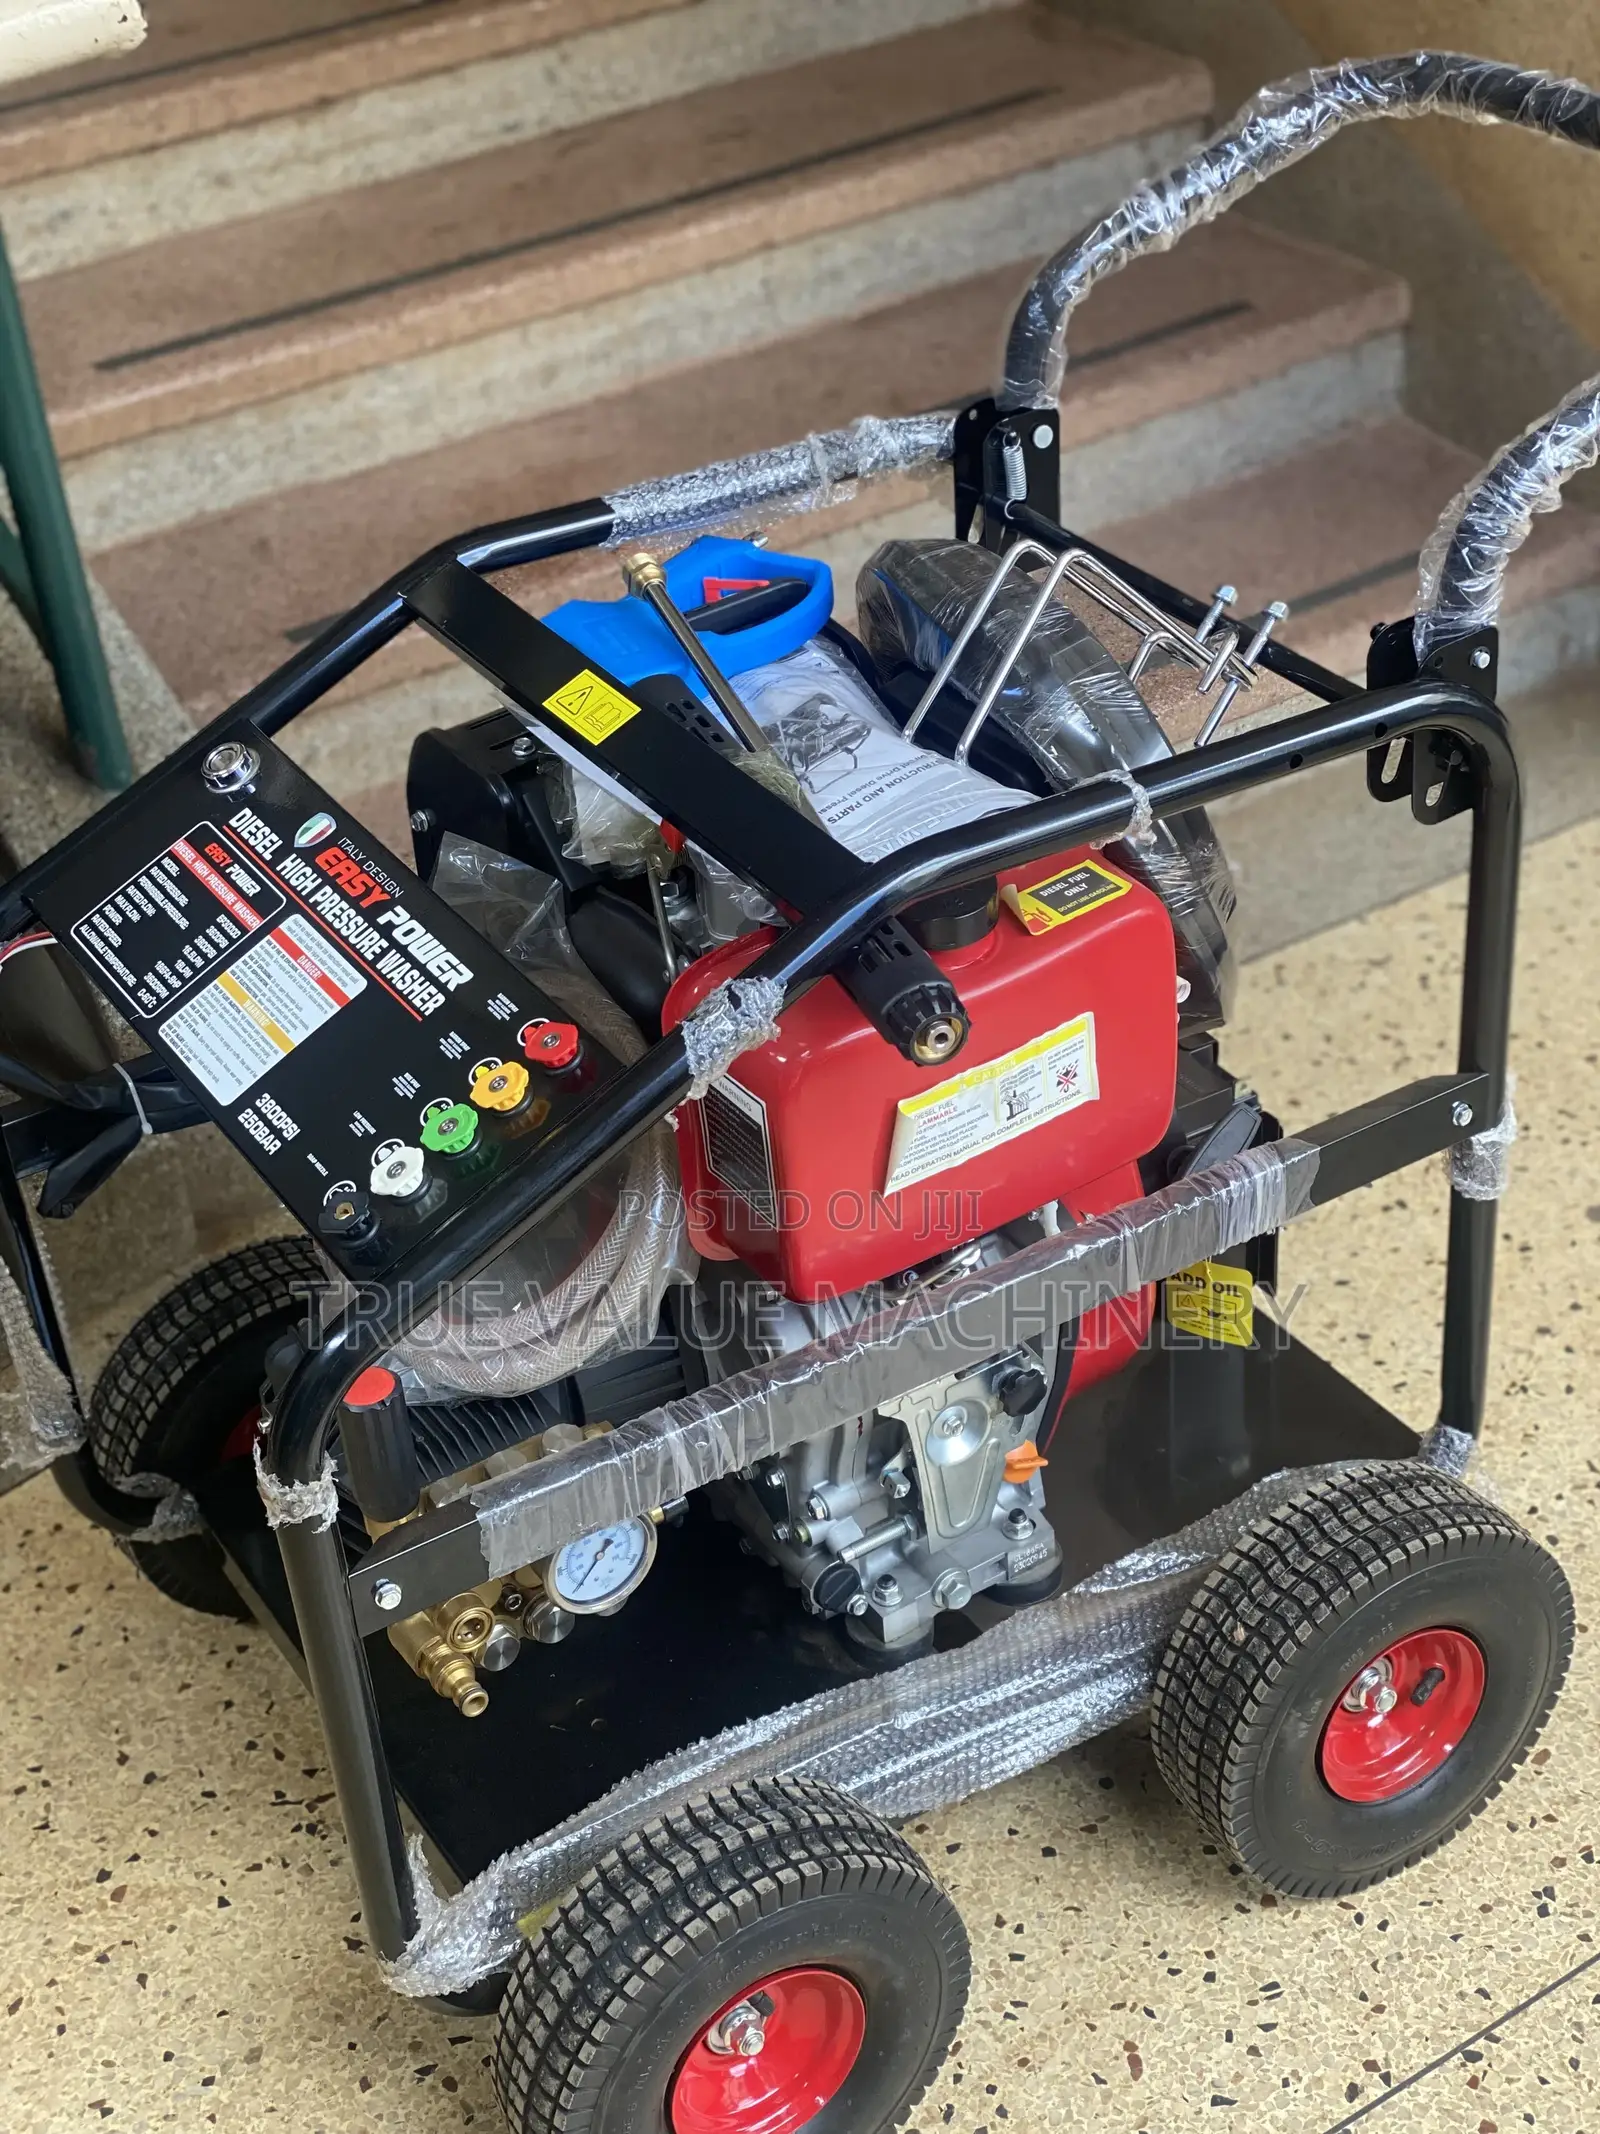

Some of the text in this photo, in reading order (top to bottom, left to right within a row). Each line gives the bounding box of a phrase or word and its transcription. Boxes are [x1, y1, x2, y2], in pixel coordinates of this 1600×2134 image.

[878, 765, 901, 781] Drive
[847, 779, 875, 798] Diesel
[861, 785, 885, 803] AND
[825, 798, 864, 825] PARTS
[148, 865, 167, 884] RATED
[160, 856, 181, 876] MODEL:
[203, 841, 261, 897] EASY POWER
[338, 837, 404, 898] ITALY DESIGN
[125, 884, 144, 903] RATED
[173, 841, 260, 928] DIESEL HIGH PRESSURE WASHER
[1040, 871, 1090, 897] DIESEL FUEL
[1064, 882, 1089, 897] ONLY
[113, 894, 129, 909] MAX
[228, 808, 284, 861] DIESEL
[276, 853, 322, 896] HIGH
[310, 885, 389, 960] PRESSURE
[376, 949, 447, 1017] WASHER
[90, 913, 109, 932] RATED
[315, 846, 391, 908] EASY
[377, 905, 474, 992] POWER
[77, 923, 109, 954] ALLOWABLE
[296, 954, 323, 980] DANGER!
[241, 998, 271, 1028] WARNING!
[973, 1059, 1016, 1083] CAUTION
[255, 1093, 301, 1141] 3800PSI
[938, 1100, 955, 1112] FUEL
[237, 1108, 282, 1156] 250BAR
[911, 1153, 952, 1174] OPERATION
[953, 1140, 980, 1157] MANUAL
[981, 1131, 996, 1143] FOR
[996, 1114, 1032, 1136] COMPLETE
[1170, 1272, 1243, 1298] ADD OIL
